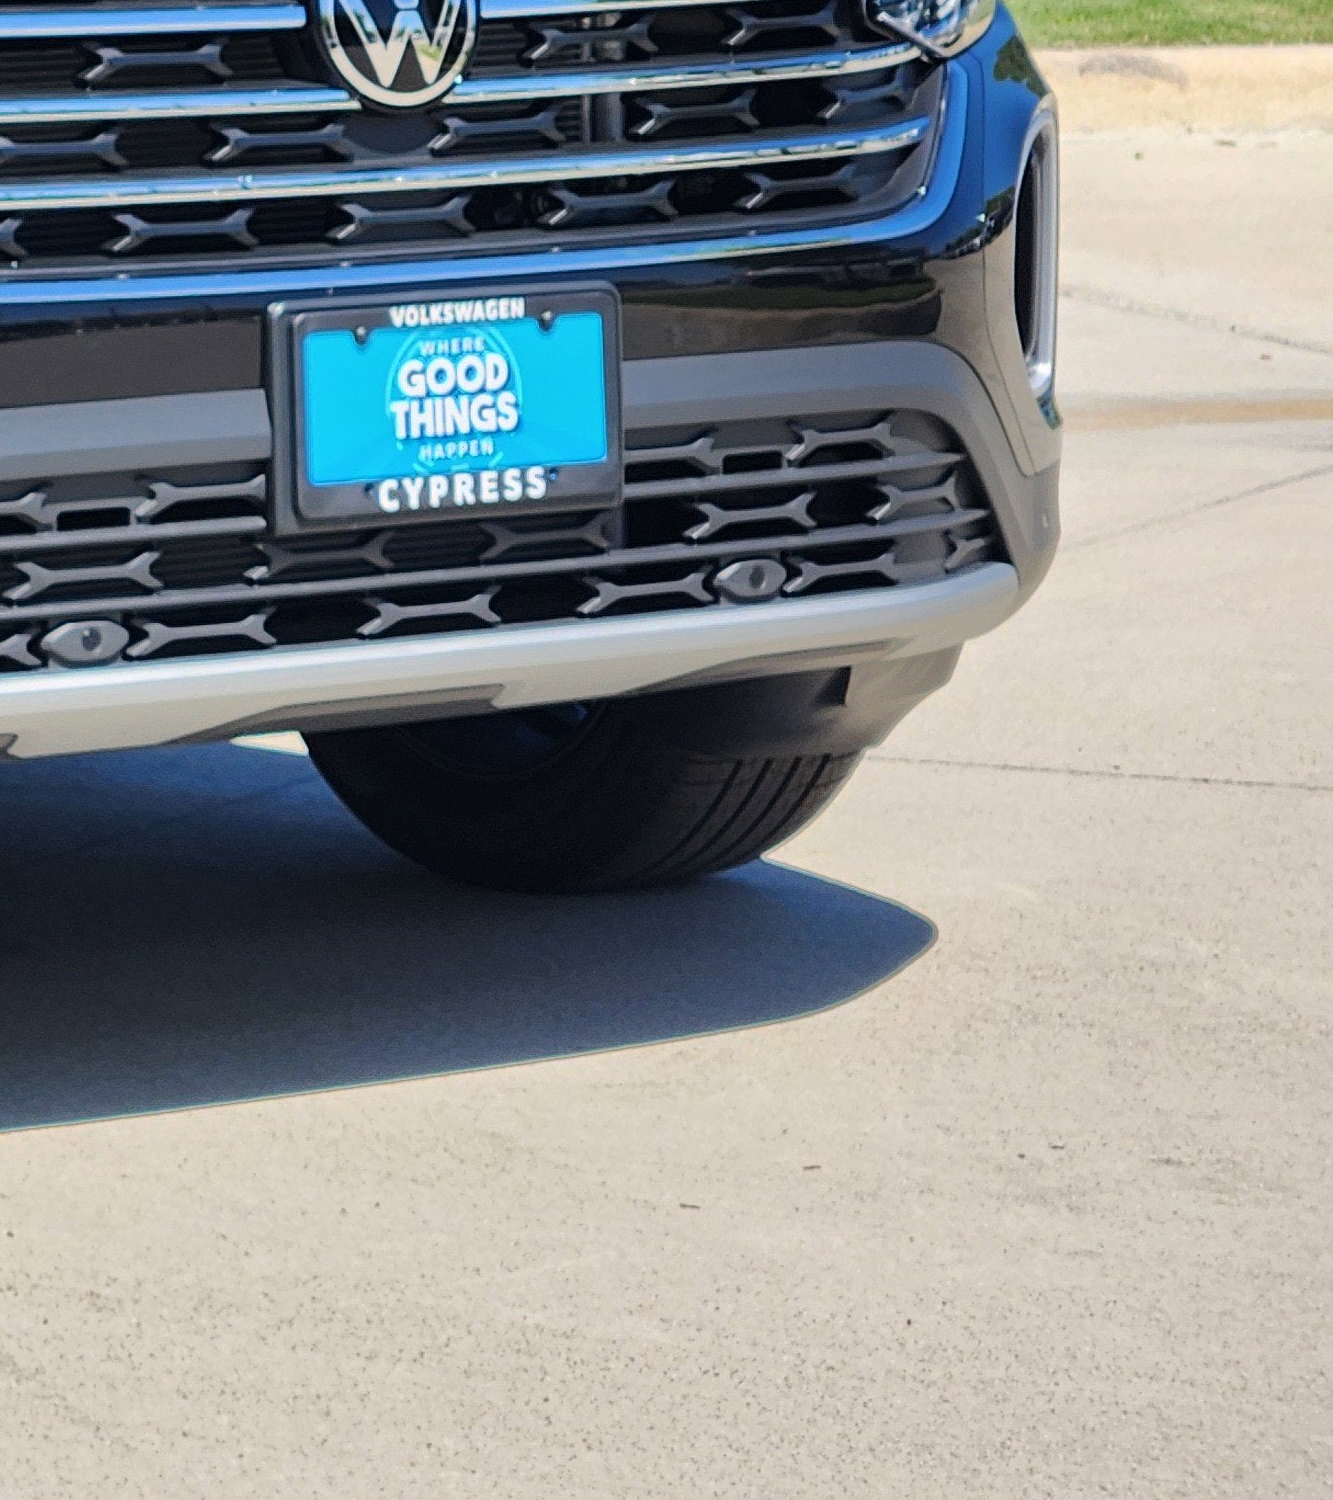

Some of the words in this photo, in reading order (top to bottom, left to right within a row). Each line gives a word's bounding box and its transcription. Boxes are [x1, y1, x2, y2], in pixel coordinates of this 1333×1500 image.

[390, 298, 524, 327] VOLKSWAGEN
[421, 339, 485, 354] WHERE
[399, 354, 508, 397] GOOD
[391, 392, 518, 439] THINGS
[421, 439, 494, 460] HAPPEN
[379, 467, 547, 512] CYPRESS
